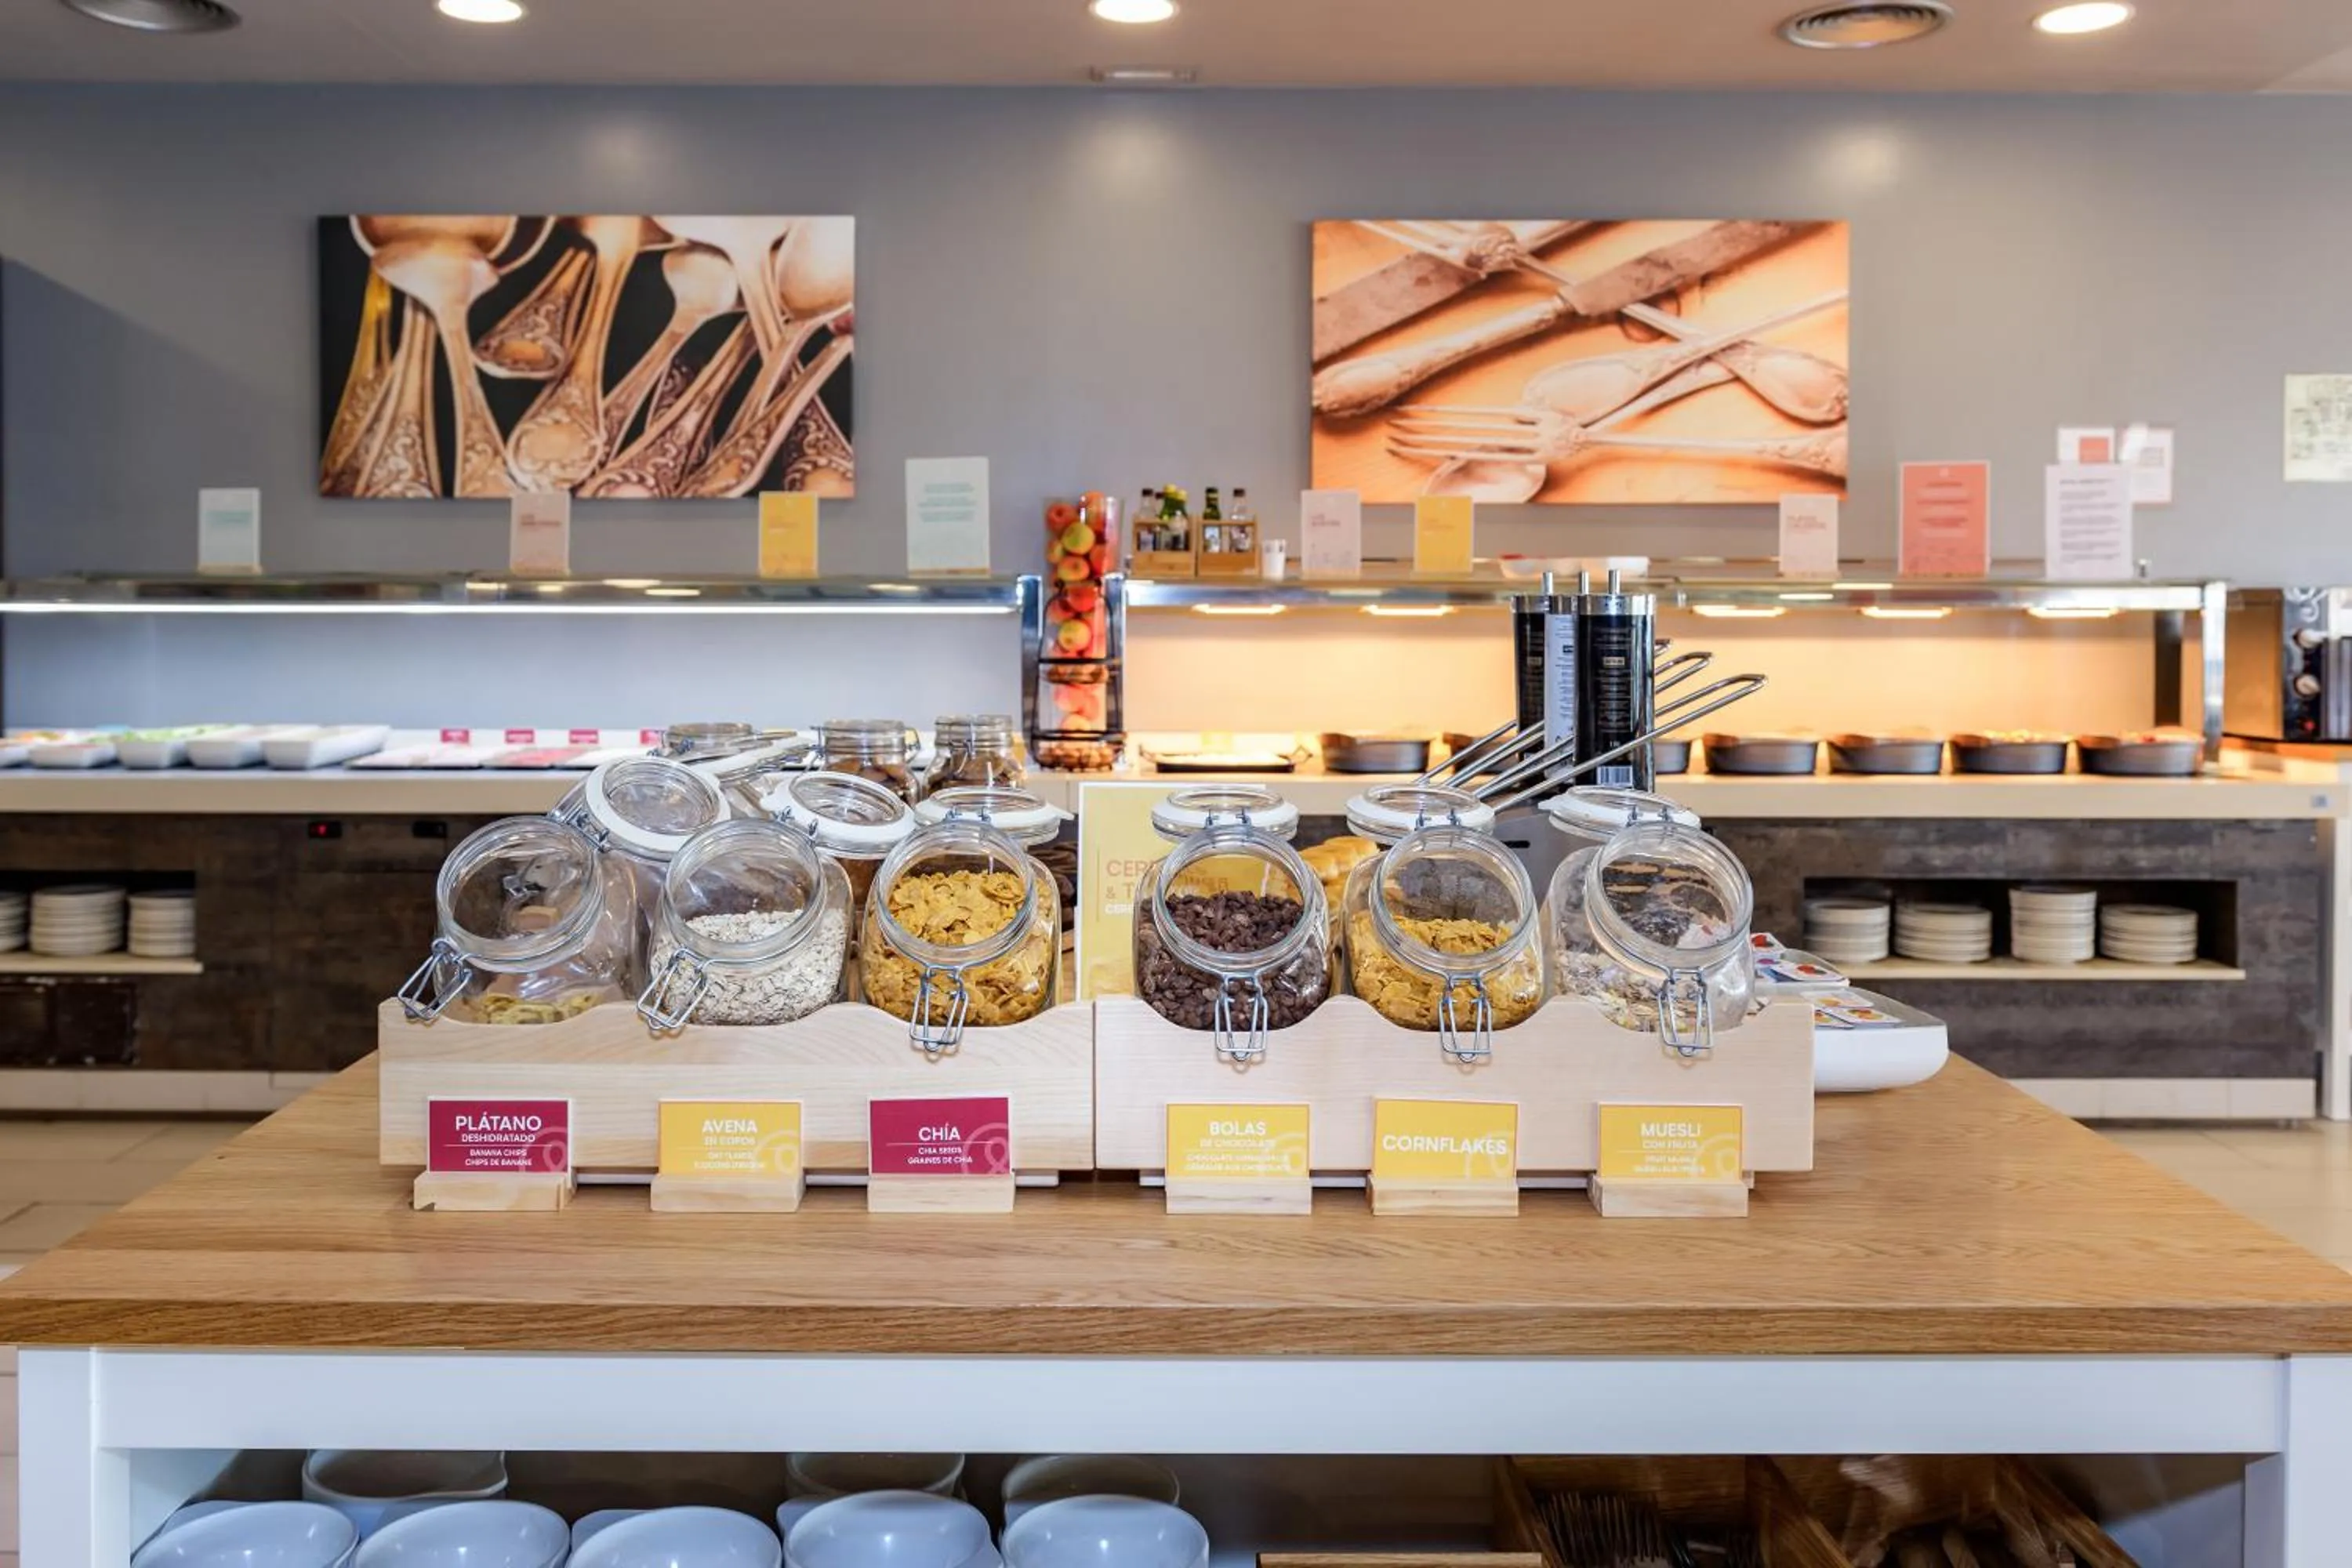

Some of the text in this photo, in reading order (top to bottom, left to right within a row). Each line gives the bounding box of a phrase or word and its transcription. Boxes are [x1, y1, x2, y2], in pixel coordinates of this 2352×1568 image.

[455, 1111, 543, 1131] PLÁTANO
[702, 1119, 758, 1134] AVENA
[1209, 1121, 1267, 1136] BOLAS
[918, 1121, 961, 1142] CHÍA
[1640, 1122, 1702, 1137] MUESLI
[461, 1134, 536, 1143] DESHIDRATADO
[1382, 1134, 1508, 1156] CORNFLAKES
[470, 1149, 528, 1157] BANANA CHIPS
[918, 1147, 938, 1156] CHIA
[465, 1158, 488, 1167] CHIPS
